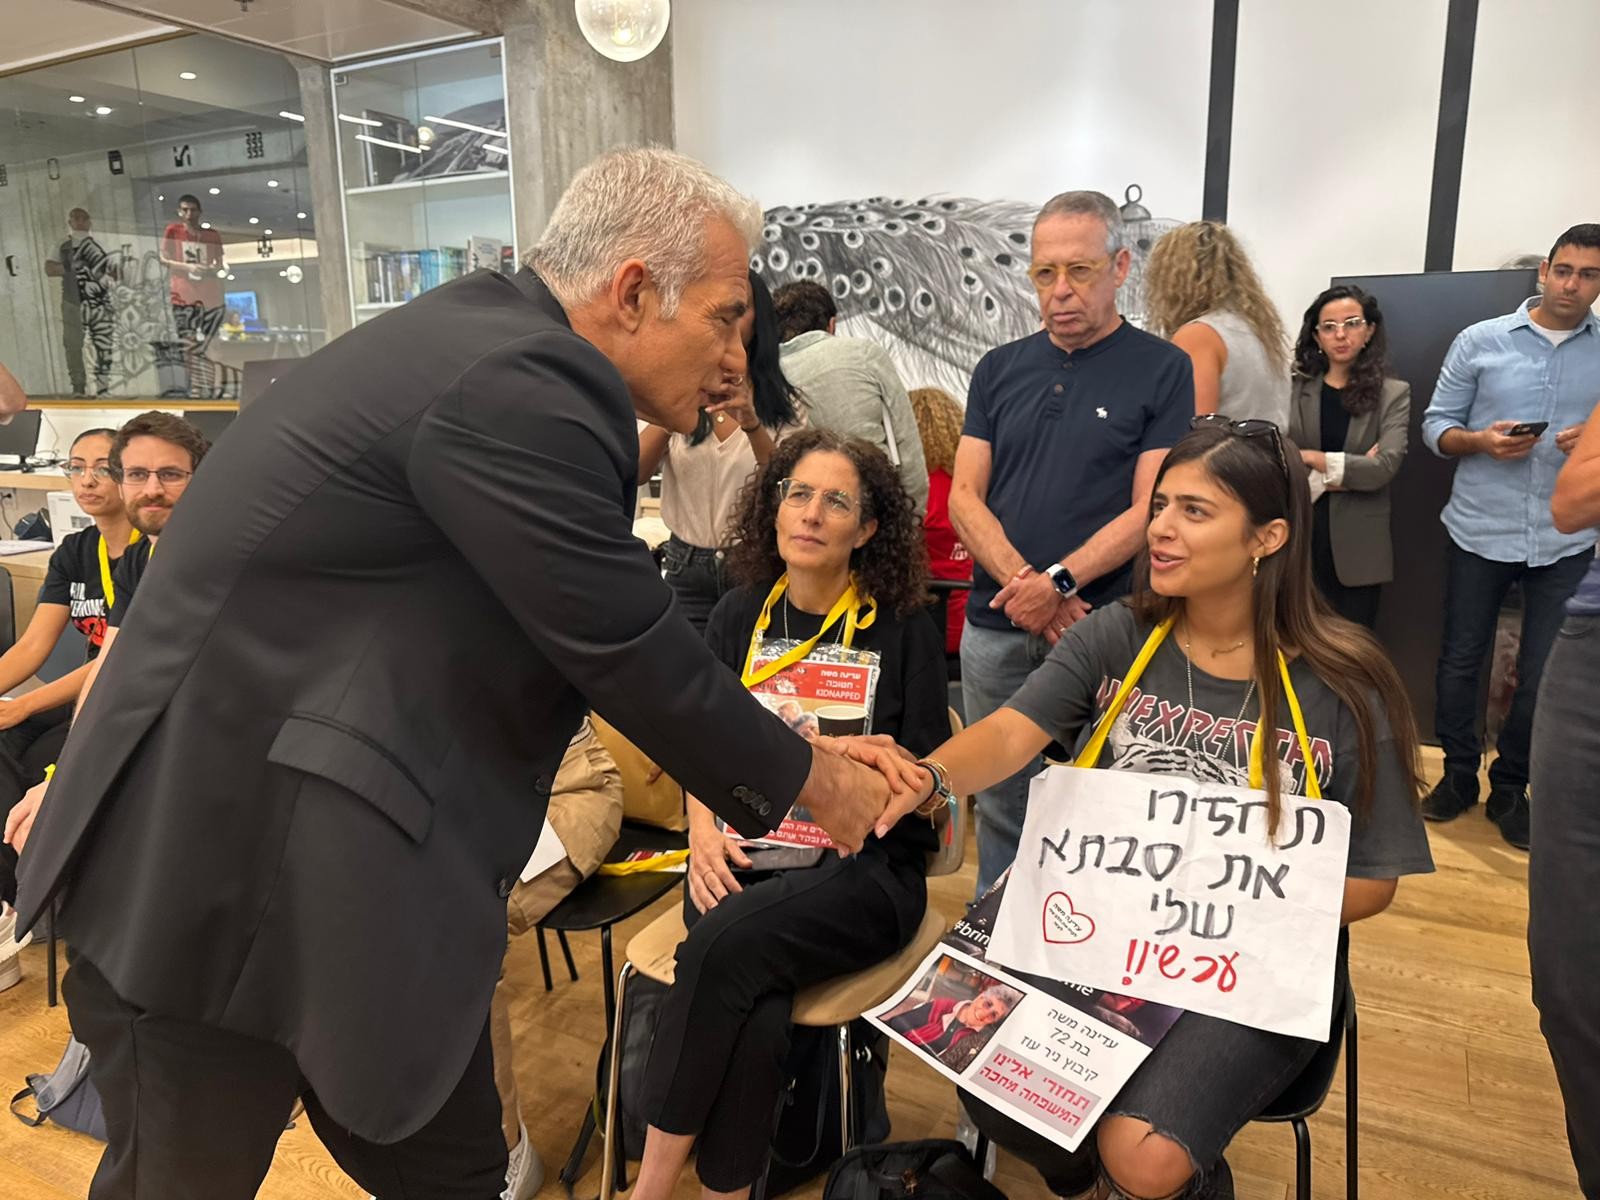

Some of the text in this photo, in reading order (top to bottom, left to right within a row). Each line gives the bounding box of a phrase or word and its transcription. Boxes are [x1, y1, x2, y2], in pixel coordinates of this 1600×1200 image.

[816, 688, 861, 700] KIDNAPPED
[1038, 828, 1290, 899] את סבתא
[954, 920, 990, 950] #brin
[1150, 888, 1234, 940] שלי
[1047, 1008, 1119, 1049] עדינה משה
[1050, 1027, 1091, 1056] בת 72
[992, 1052, 1090, 1110] תחזרי אלינו
[1020, 1036, 1098, 1082] קיבוץ ניר עוז
[979, 1066, 1081, 1126] המשפחה מחכה
